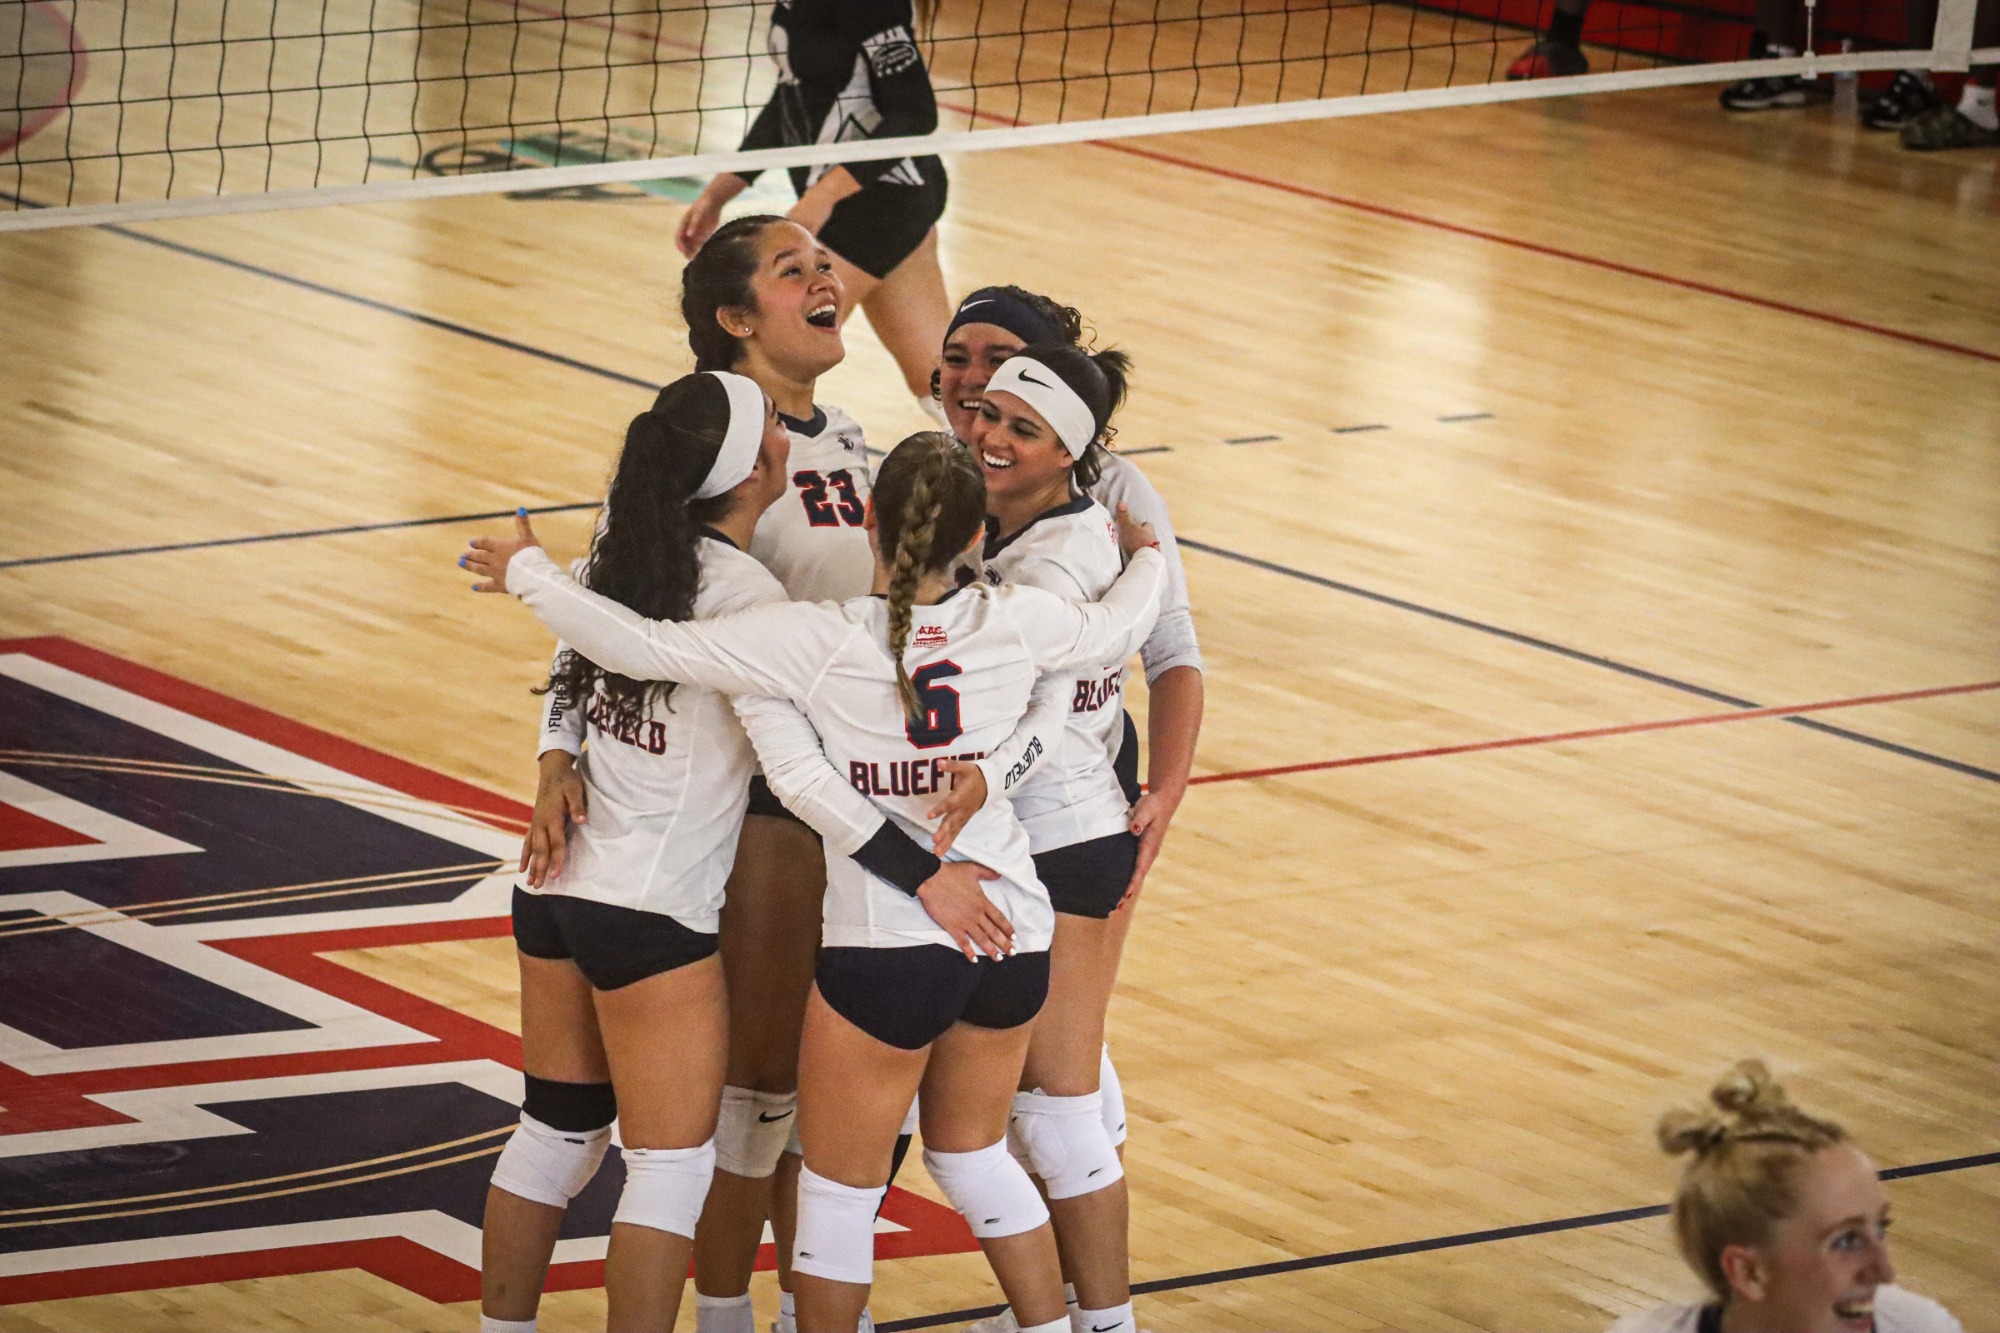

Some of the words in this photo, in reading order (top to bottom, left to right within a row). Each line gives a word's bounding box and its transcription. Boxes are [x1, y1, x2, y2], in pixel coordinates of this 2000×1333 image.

[793, 469, 864, 527] 23
[919, 625, 942, 635] AAC
[905, 659, 963, 749] 6
